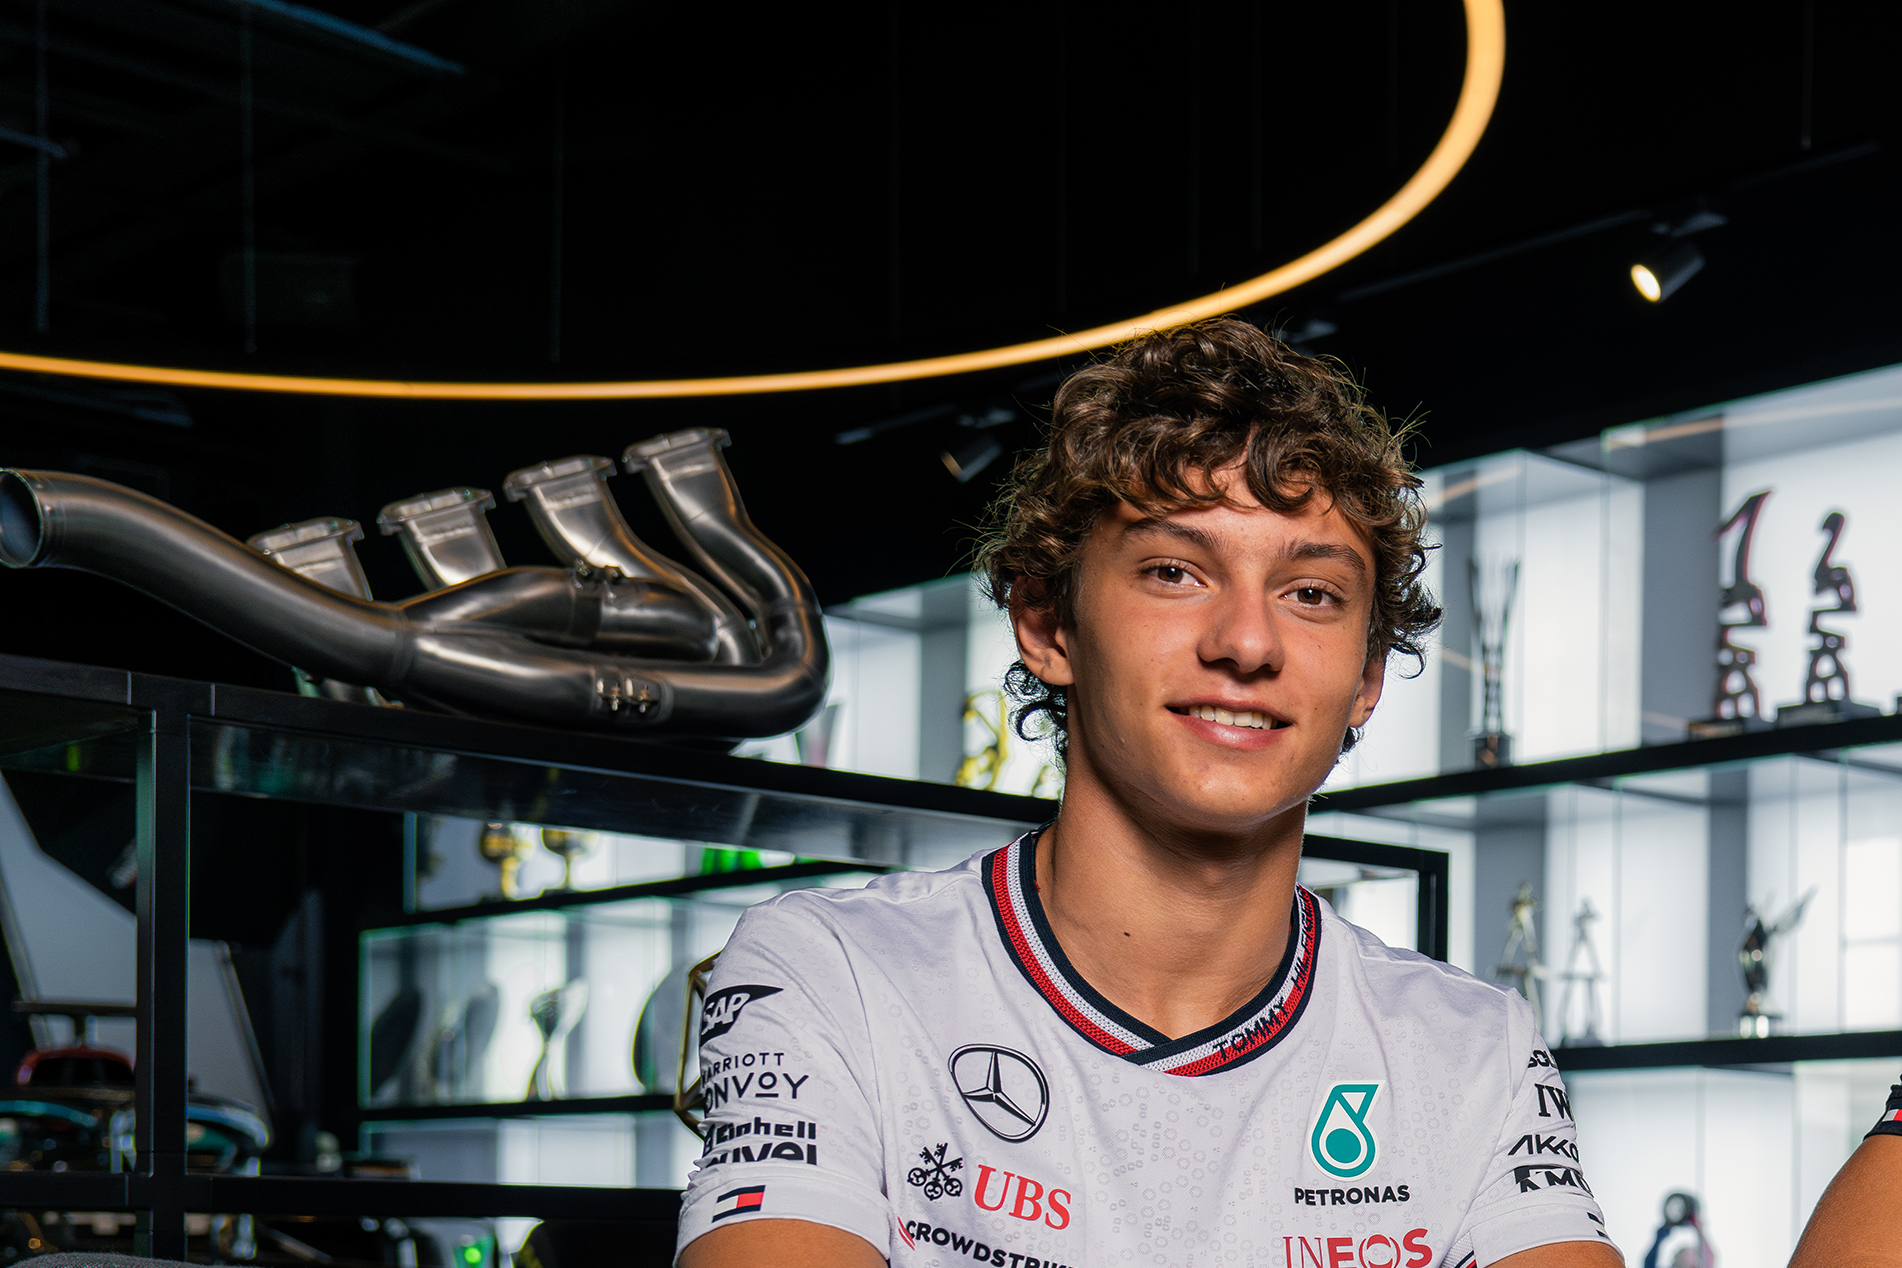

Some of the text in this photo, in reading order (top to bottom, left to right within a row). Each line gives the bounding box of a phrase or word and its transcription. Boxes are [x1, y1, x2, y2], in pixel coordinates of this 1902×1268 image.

[1213, 996, 1290, 1060] TOMMY
[703, 1071, 809, 1114] ONVOY
[1534, 1083, 1575, 1122] IW
[716, 1116, 817, 1146] Einhell
[1507, 1134, 1579, 1164] AKKO
[974, 1164, 1072, 1230] UBS
[1294, 1184, 1411, 1206] PETRONAS
